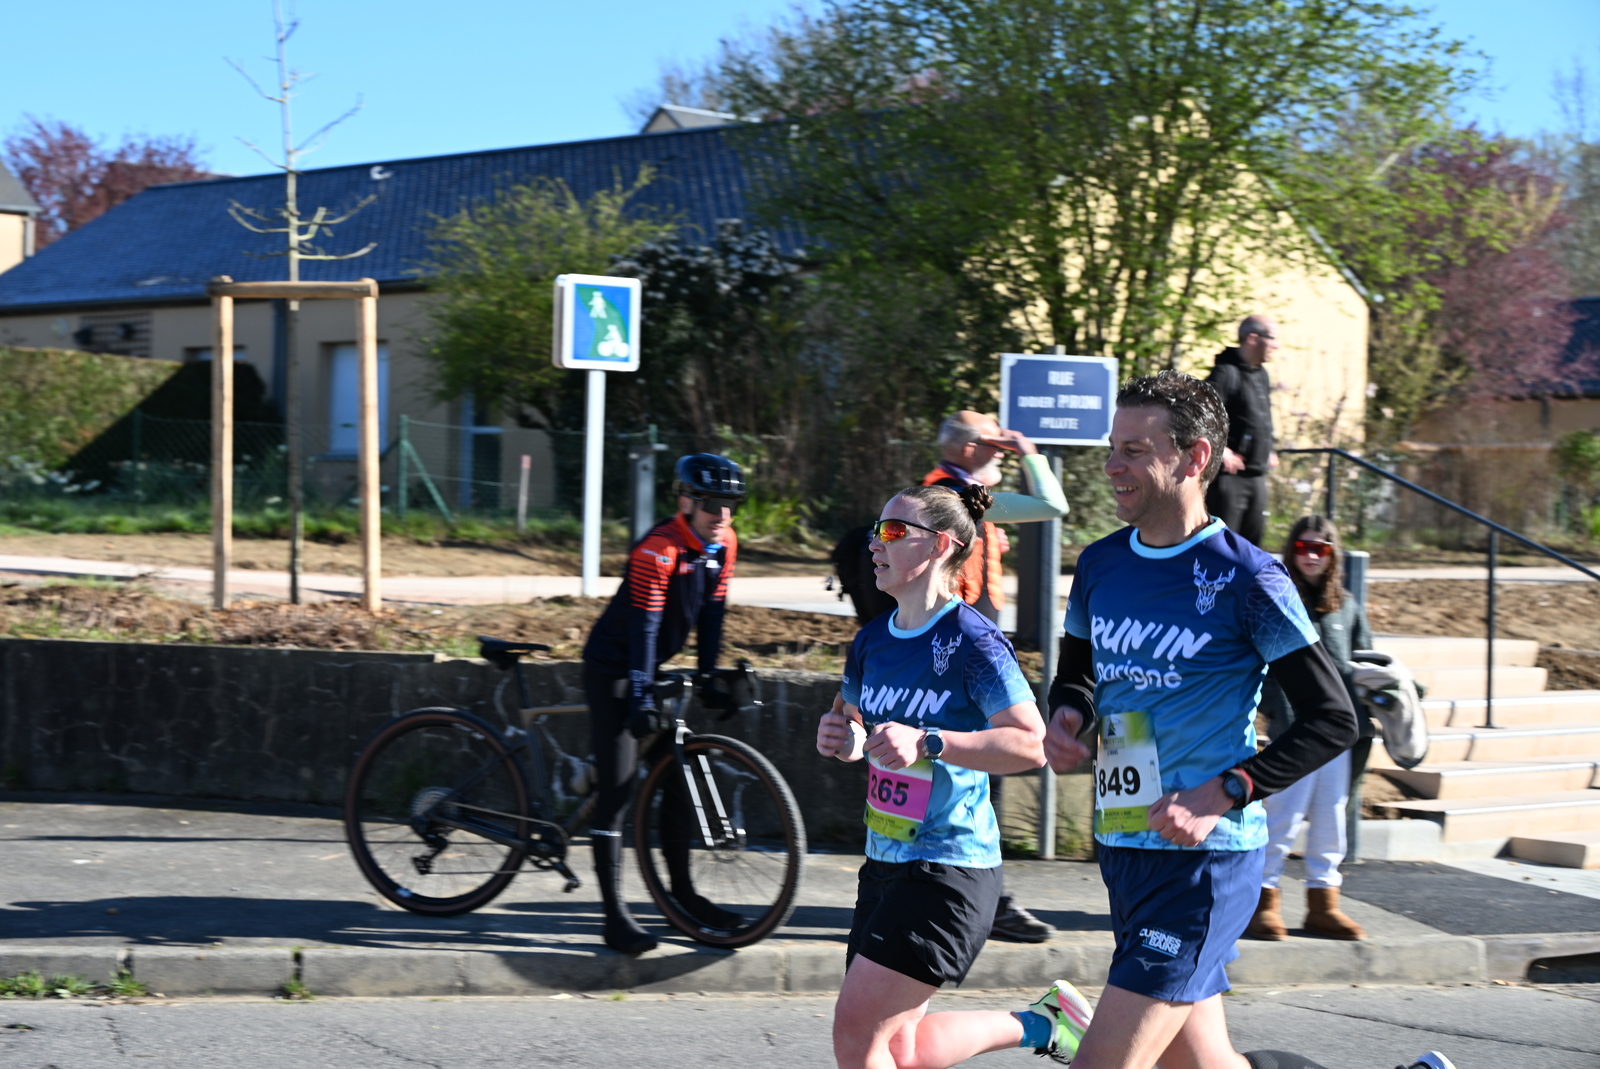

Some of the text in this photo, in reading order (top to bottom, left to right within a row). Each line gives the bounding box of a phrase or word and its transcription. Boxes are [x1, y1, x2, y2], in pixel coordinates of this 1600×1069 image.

[1048, 371, 1075, 386] RUE
[1040, 417, 1079, 429] PILOTE
[1091, 614, 1213, 662] RUN'IN
[870, 773, 910, 807] 265
[1099, 766, 1141, 798] 849
[1139, 928, 1182, 948] CUISINES
[1149, 936, 1179, 954] BAINS
